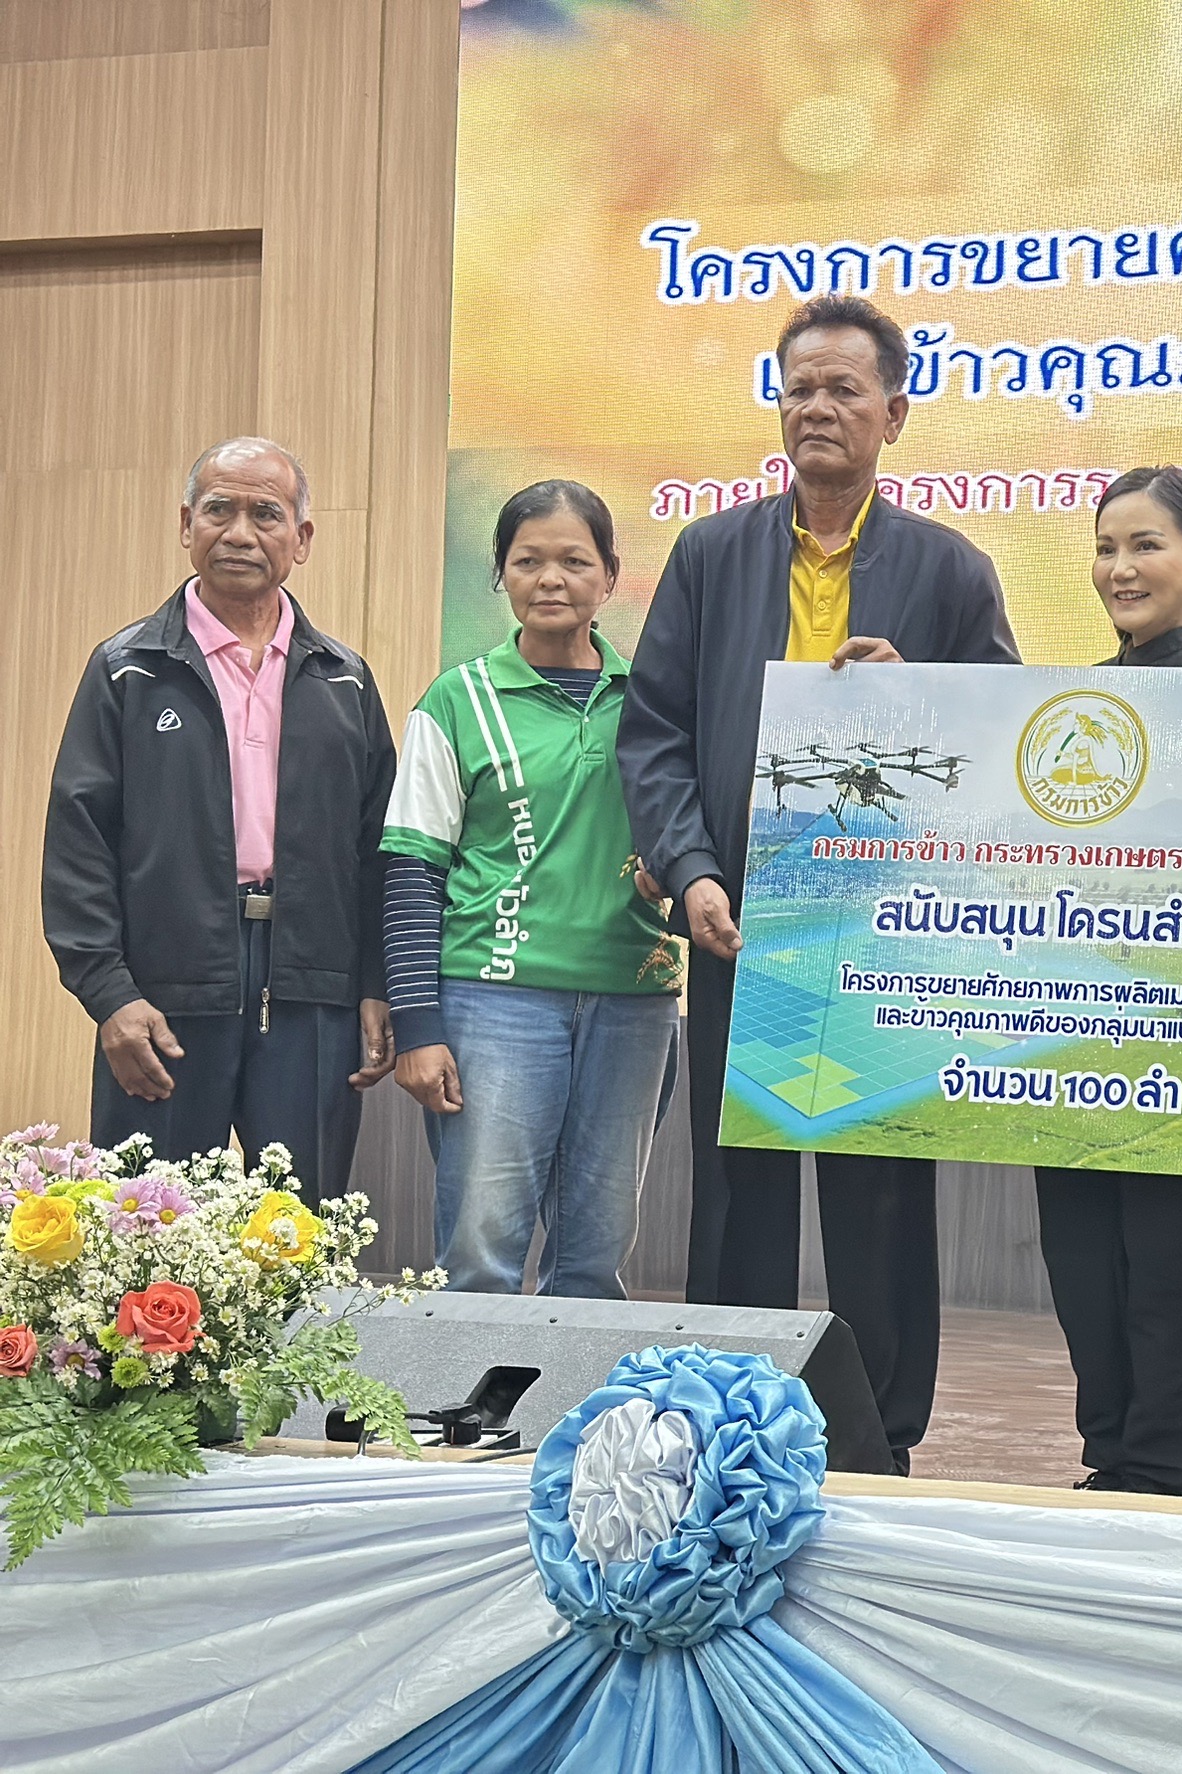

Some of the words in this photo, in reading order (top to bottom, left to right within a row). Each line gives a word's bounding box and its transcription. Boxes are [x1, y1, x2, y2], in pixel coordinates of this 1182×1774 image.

[1031, 777, 1128, 815] กรมการข้าว
[814, 830, 966, 862] กรมการข้าว
[876, 888, 1046, 951] สนับสนุน
[943, 1057, 1053, 1102] จำนวน
[1064, 1076, 1128, 1106] 100
[1136, 1068, 1179, 1109] ลำ
